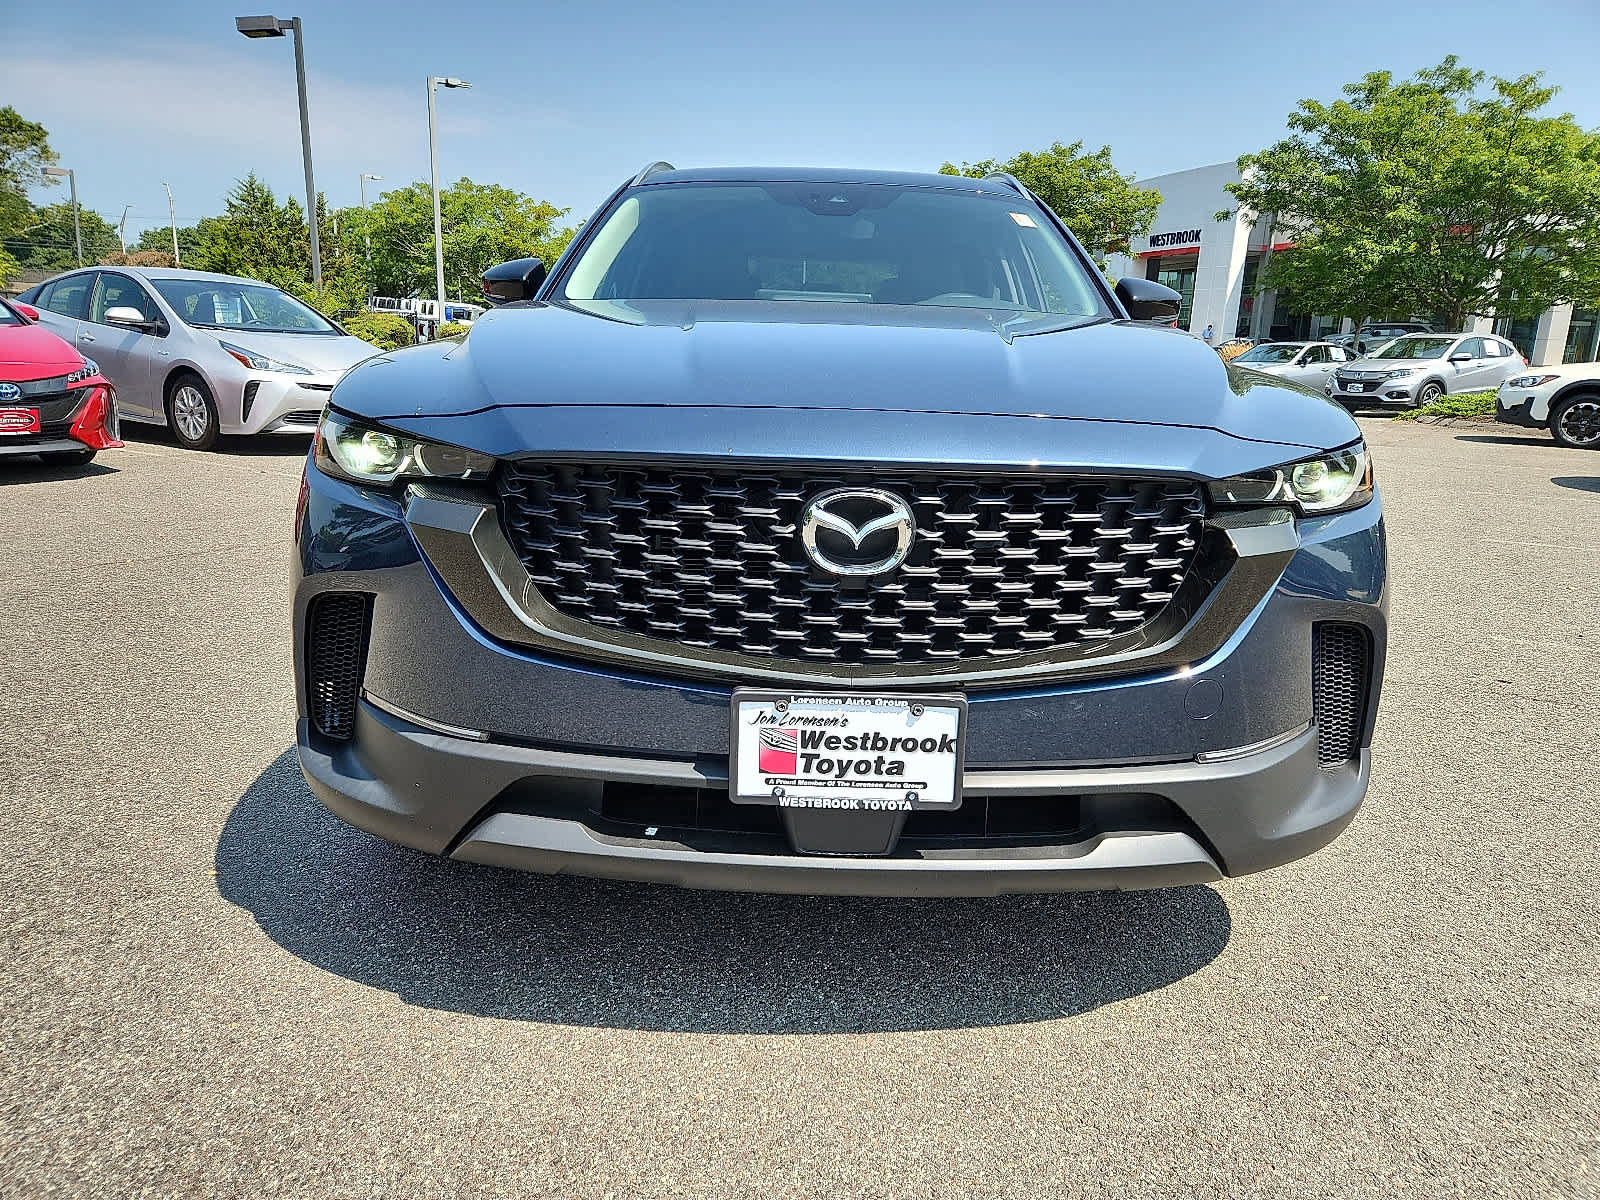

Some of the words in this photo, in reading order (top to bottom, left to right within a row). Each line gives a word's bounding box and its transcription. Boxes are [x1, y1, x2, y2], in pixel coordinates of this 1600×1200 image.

[1149, 229, 1202, 247] WESTBROOK
[790, 696, 842, 705] Lorensen
[845, 698, 871, 706] Auto
[875, 699, 908, 708] Group
[748, 711, 778, 725] Jon
[778, 712, 848, 727] Lorensen's
[801, 730, 957, 753] Westbrook
[800, 753, 905, 778] Toyota
[779, 797, 859, 809] WESTBROOK
[863, 800, 912, 811] TOYOTA
